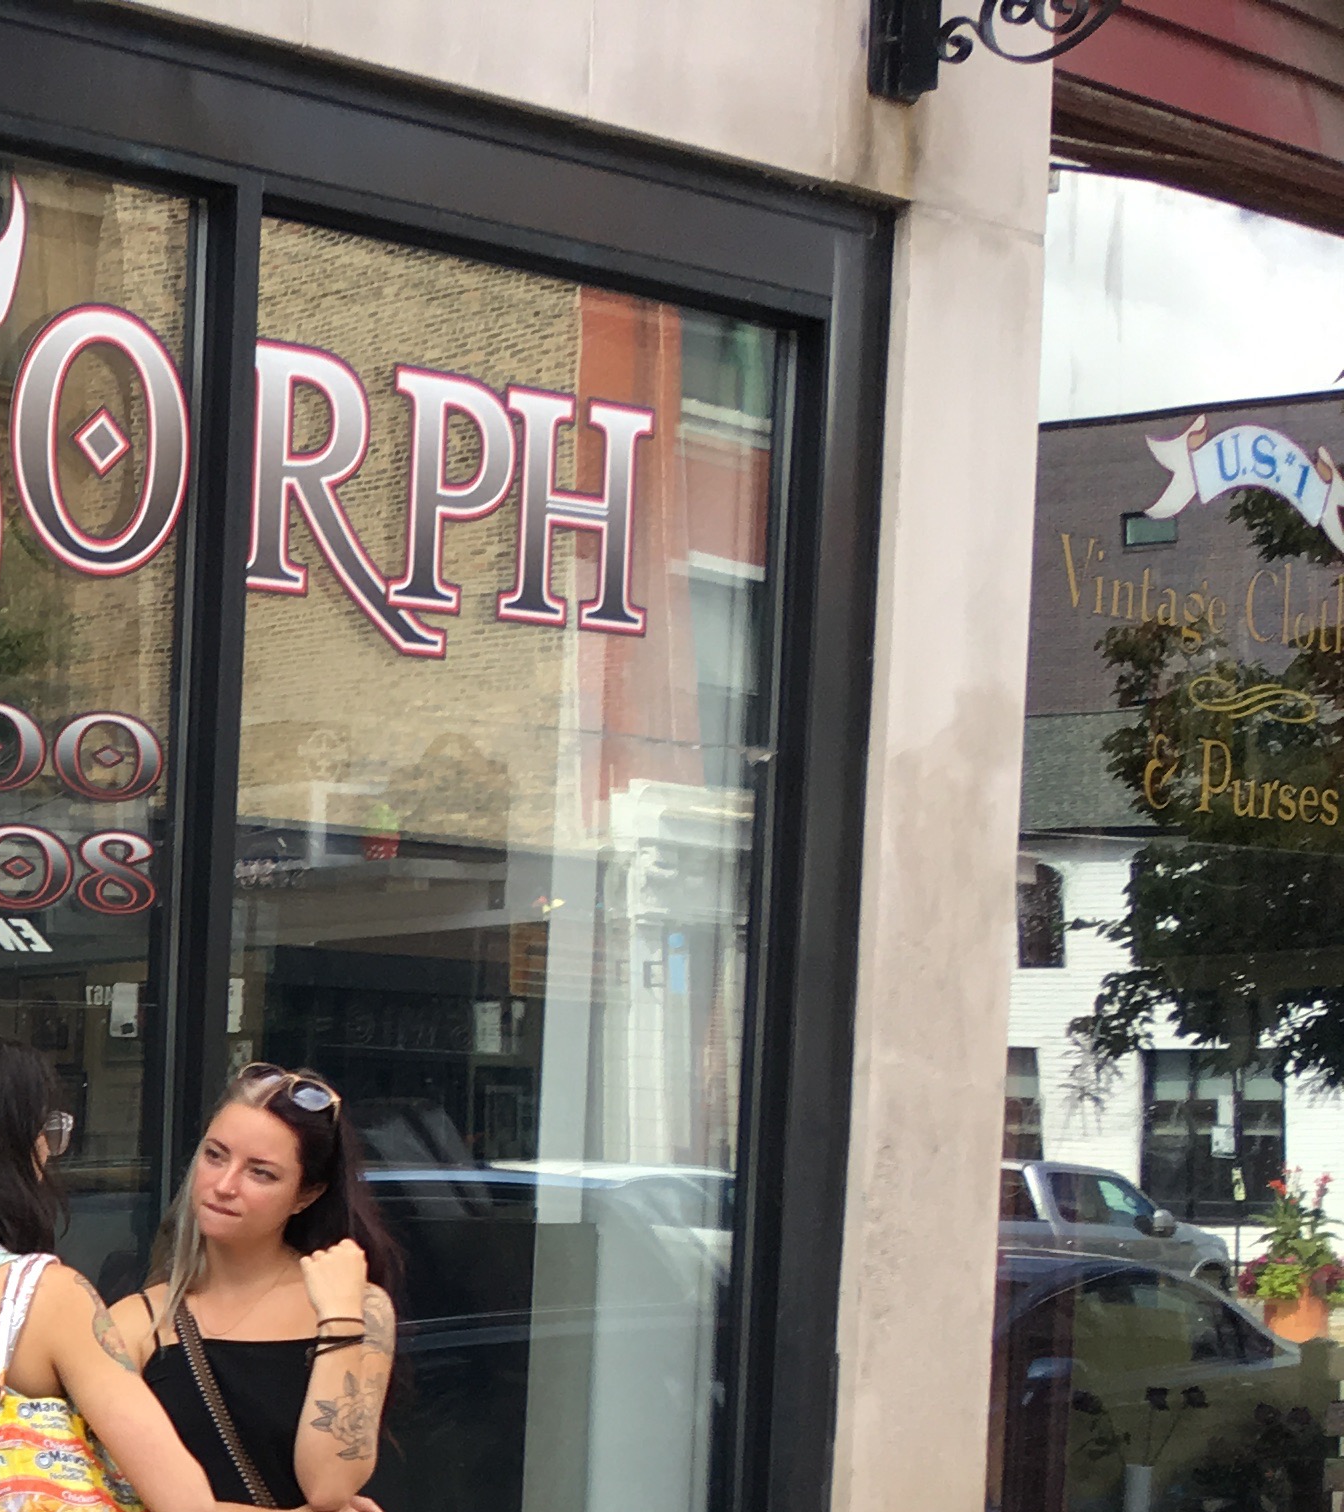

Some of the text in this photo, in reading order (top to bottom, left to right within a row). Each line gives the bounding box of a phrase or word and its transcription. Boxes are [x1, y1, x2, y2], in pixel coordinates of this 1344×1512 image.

[1062, 533, 1226, 653] Vintage
[1144, 734, 1341, 826] & Purses
